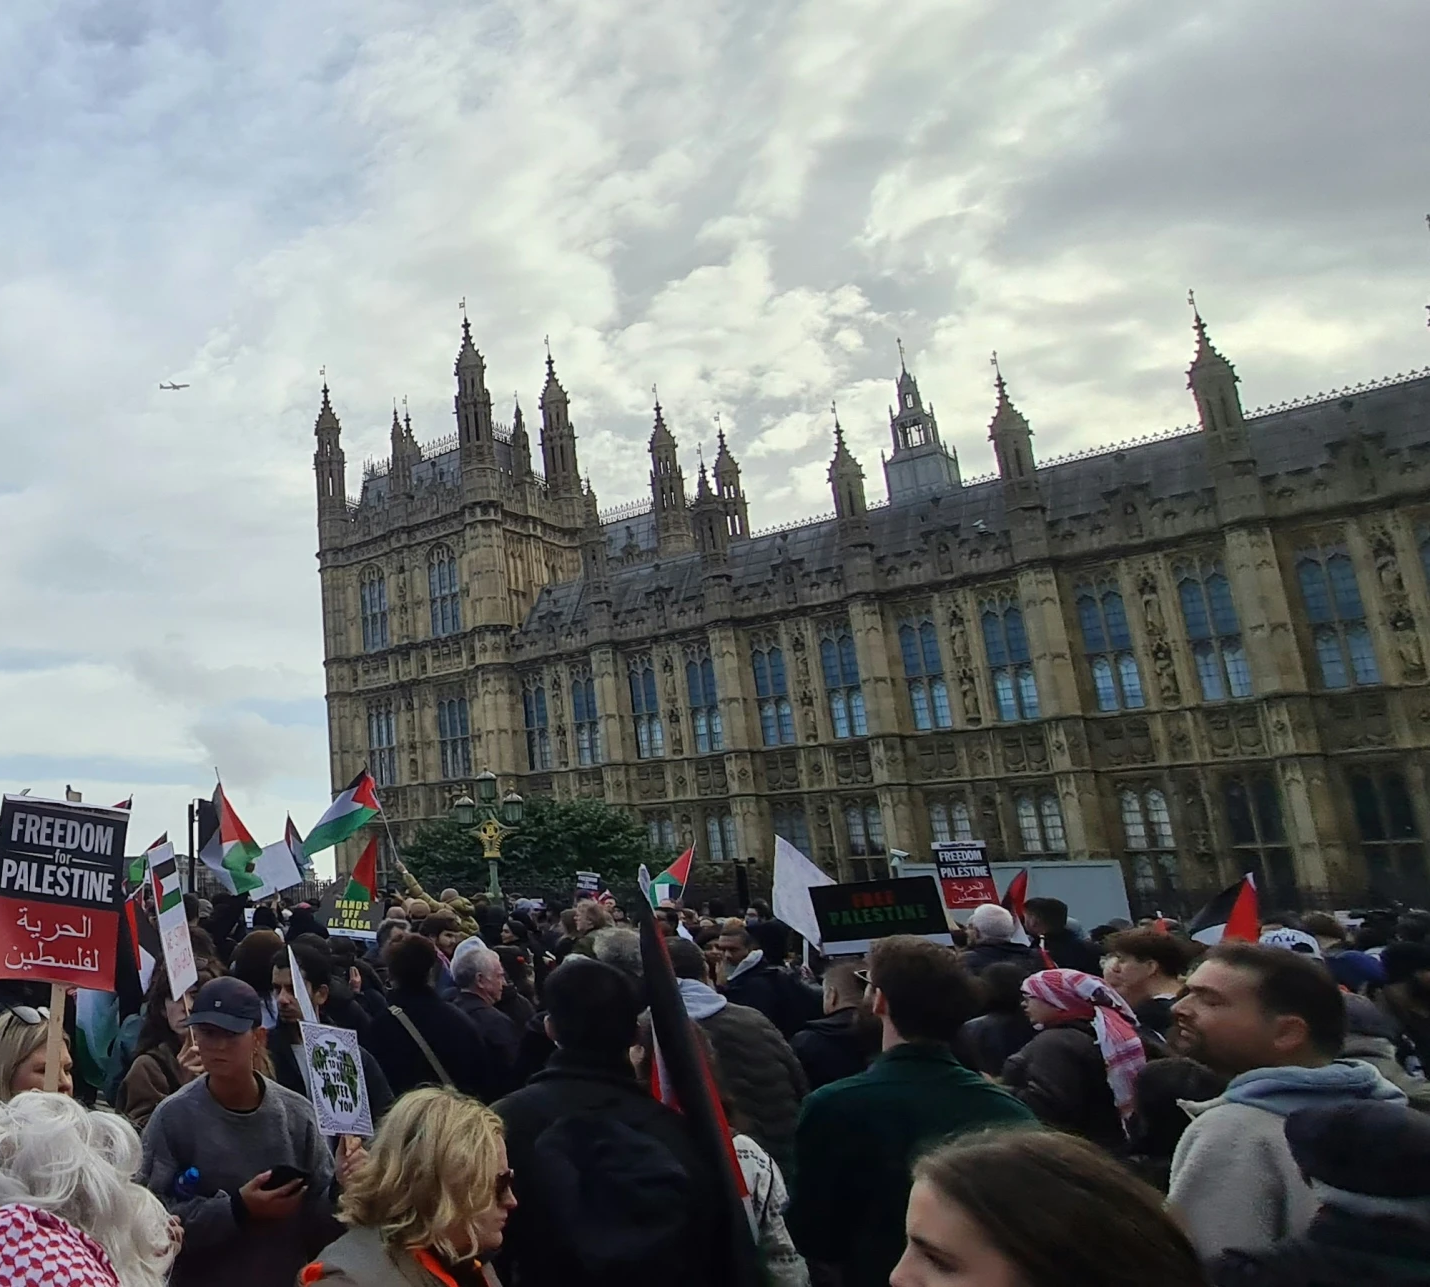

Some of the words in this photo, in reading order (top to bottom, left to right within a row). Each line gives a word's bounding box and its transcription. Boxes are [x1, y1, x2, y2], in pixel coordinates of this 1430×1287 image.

[10, 811, 114, 856] FREEDOM
[54, 848, 72, 865] for
[938, 849, 983, 862] FREEDOM
[939, 865, 990, 878] PALESTINE
[0, 858, 115, 904] PALESTINE
[335, 899, 369, 910] HANDS
[341, 909, 360, 918] OFF
[827, 904, 929, 925] PALESTINE
[16, 906, 92, 942] الحرية
[327, 917, 371, 930] AL-AQSA
[4, 941, 99, 972] لفلسطين
[337, 1100, 353, 1113] YOU
